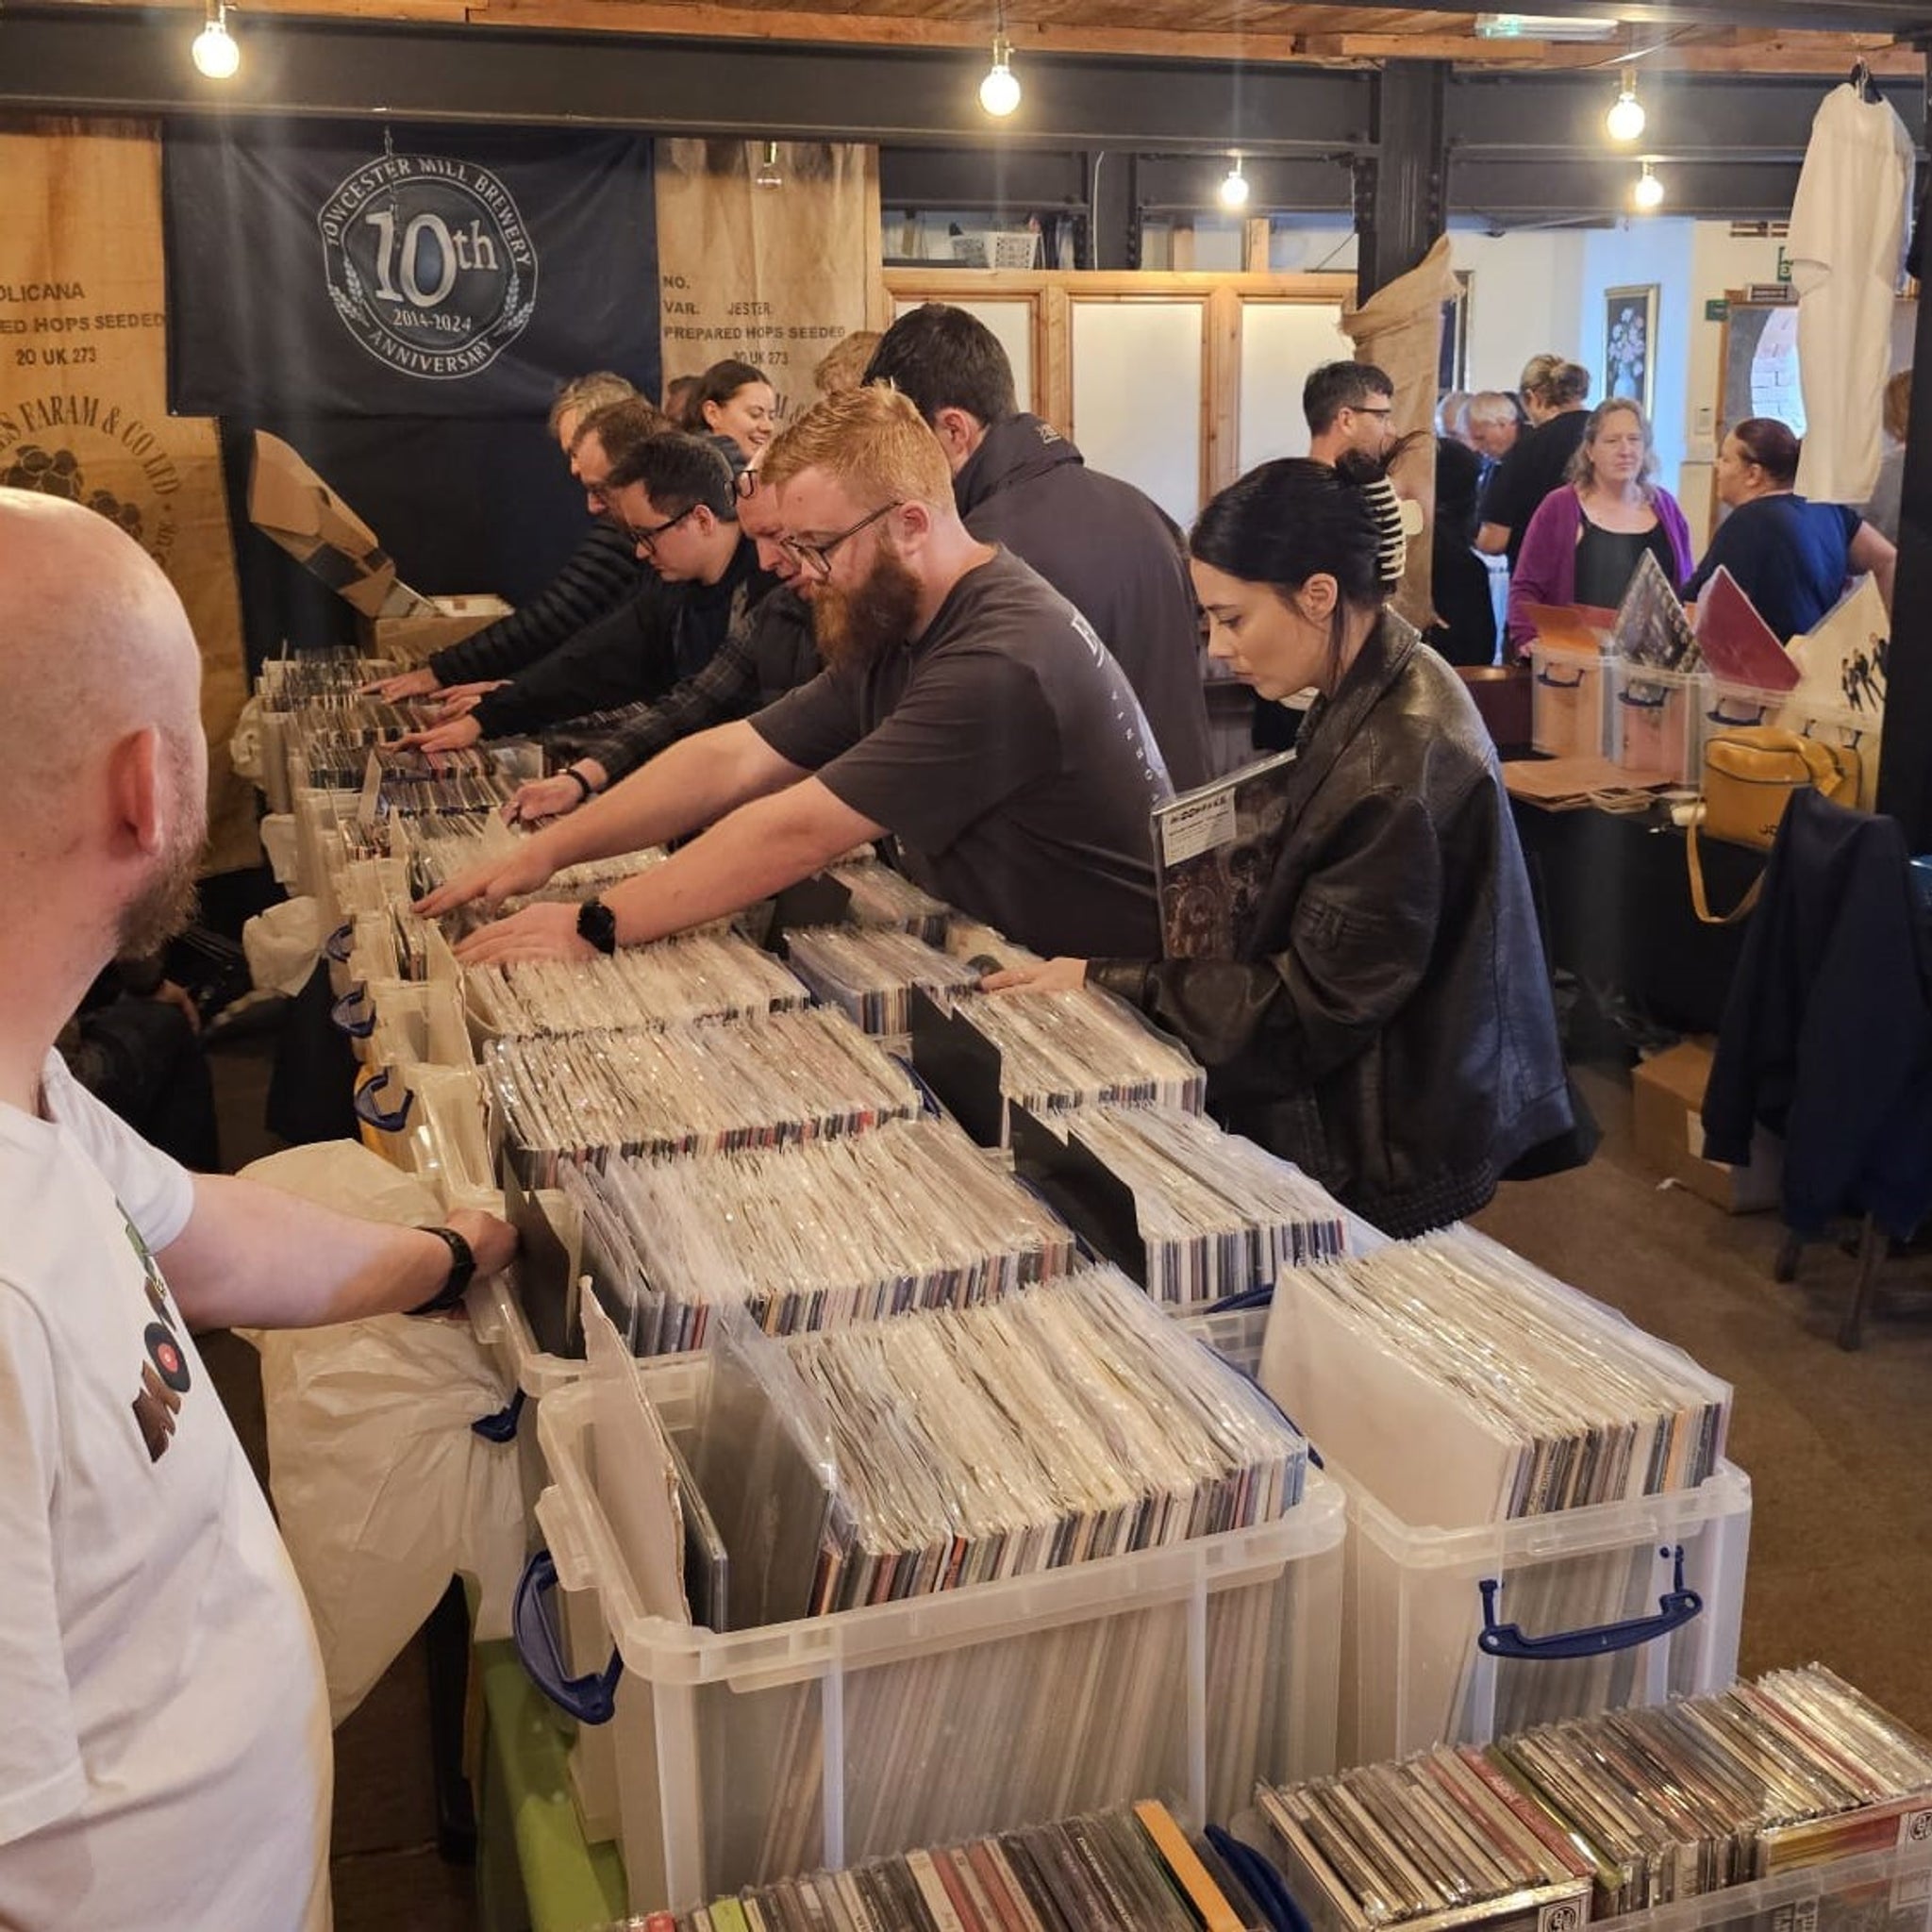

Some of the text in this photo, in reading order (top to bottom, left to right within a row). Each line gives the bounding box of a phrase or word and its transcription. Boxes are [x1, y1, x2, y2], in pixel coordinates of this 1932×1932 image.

[417, 157, 471, 182] MILL
[475, 174, 532, 267] BREWERY
[365, 210, 499, 308] 10th
[663, 275, 691, 290] NO.
[664, 300, 771, 316] VAR. JESTER
[34, 316, 91, 332] HOPS
[94, 312, 164, 330] SEEDED
[663, 326, 845, 340] PREPARED HOPS SEEDED
[17, 346, 96, 366] 20 UK 273
[369, 329, 493, 373] ANNIVERSARY
[768, 351, 789, 365] 273
[102, 406, 121, 436] &
